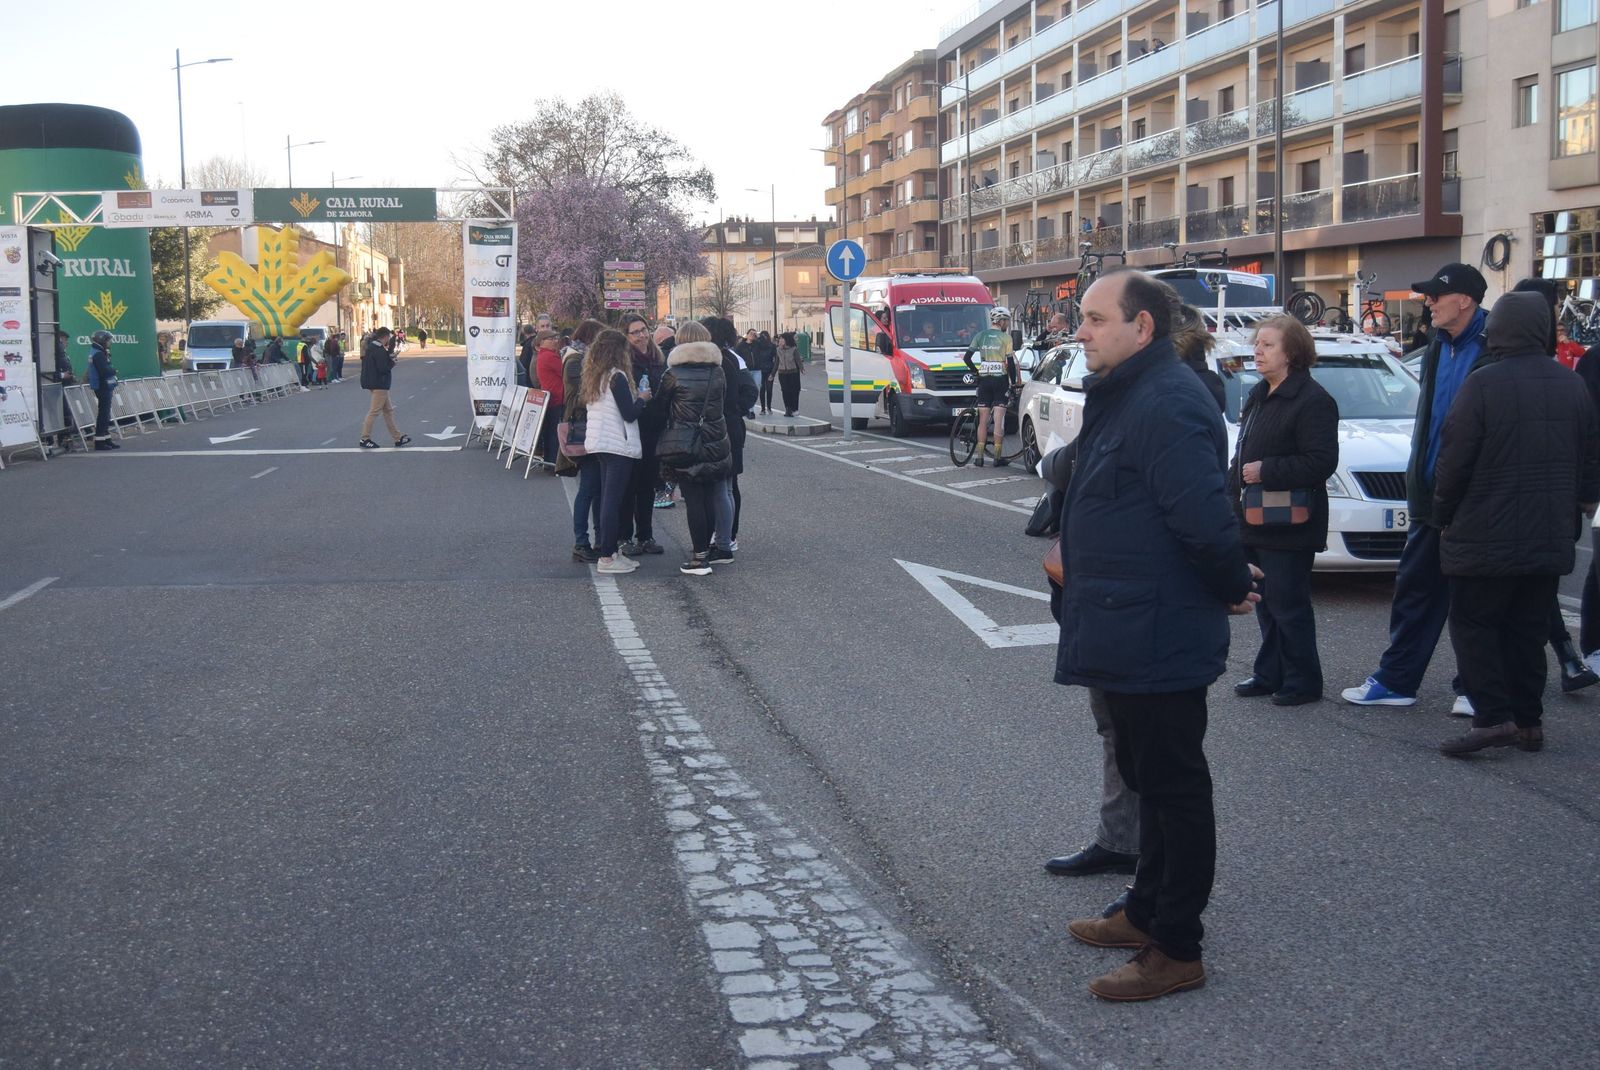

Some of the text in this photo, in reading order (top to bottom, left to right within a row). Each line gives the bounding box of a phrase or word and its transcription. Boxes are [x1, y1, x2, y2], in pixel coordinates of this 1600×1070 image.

[326, 197, 403, 209] CAJA RURAL
[185, 210, 213, 219] ARIMA
[63, 258, 136, 278] RURAL
[474, 376, 507, 387] ARIMA
